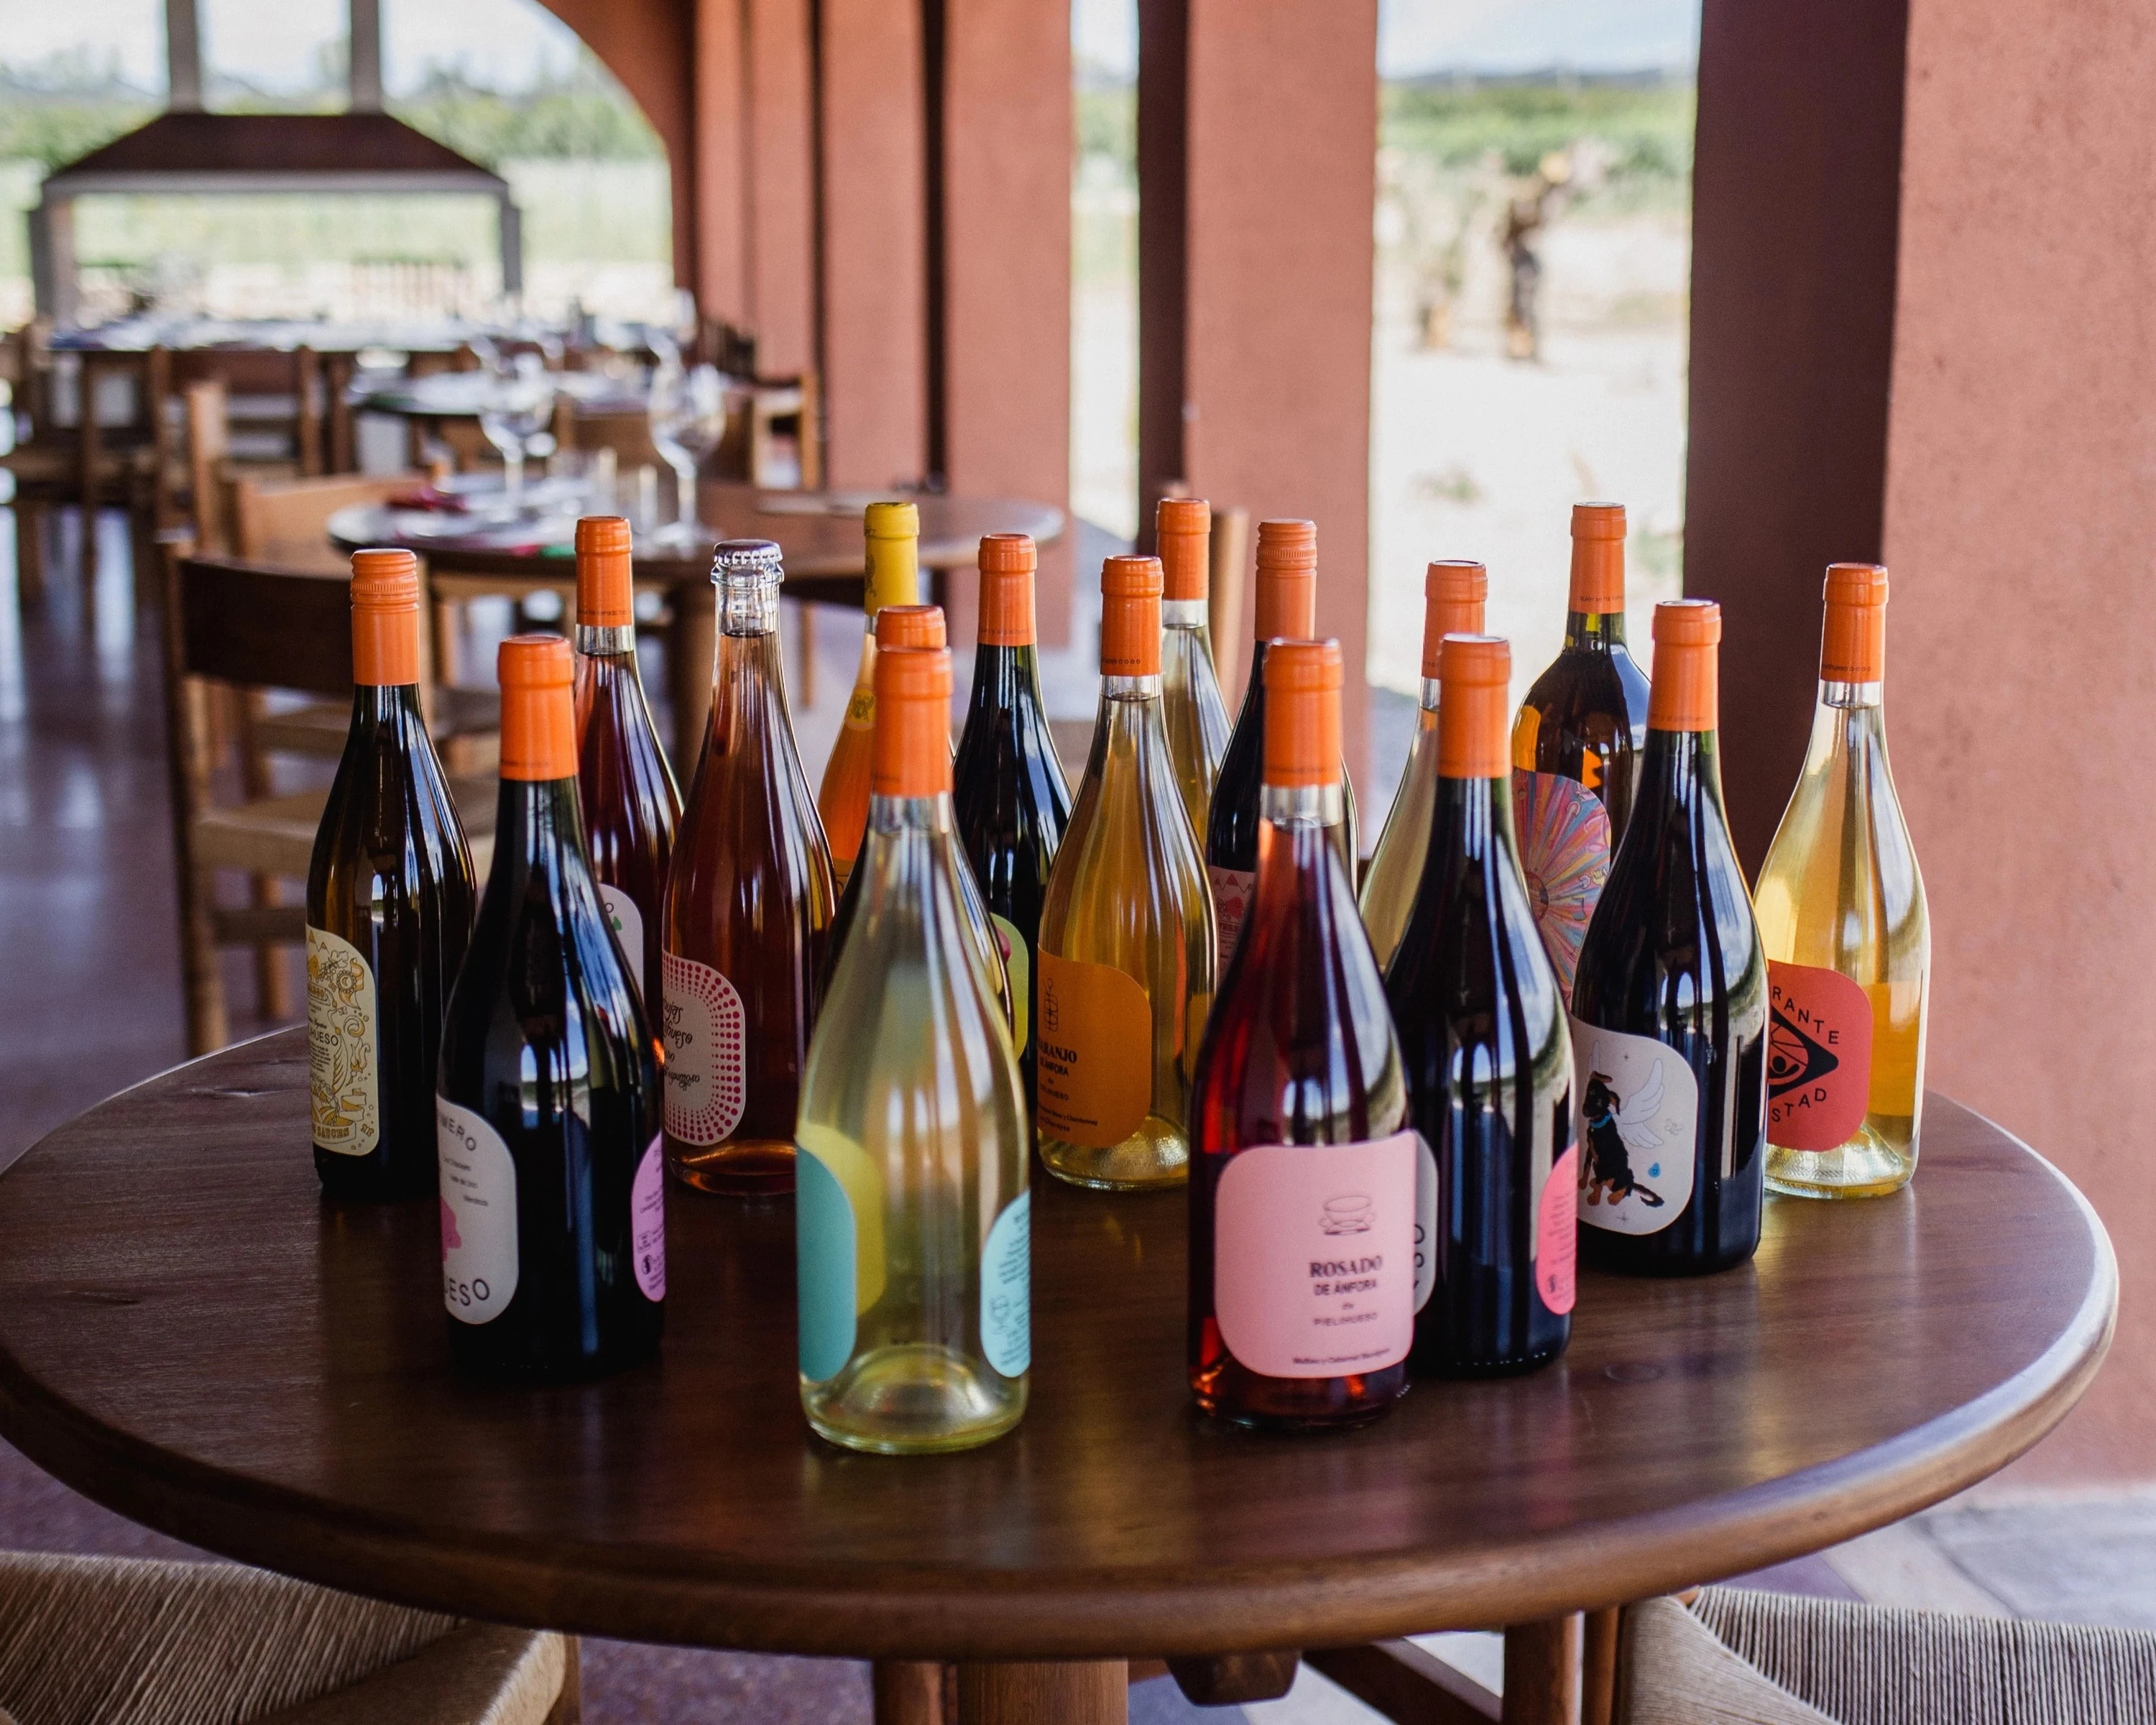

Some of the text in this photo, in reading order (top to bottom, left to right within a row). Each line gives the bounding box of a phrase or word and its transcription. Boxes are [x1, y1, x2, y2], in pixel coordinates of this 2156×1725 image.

[1772, 986, 1839, 1044] RANTE
[1772, 1087, 1826, 1123] STAD
[1309, 1256, 1383, 1277] ROSADO
[446, 1278, 490, 1307] ESO
[1314, 1283, 1330, 1295] DE
